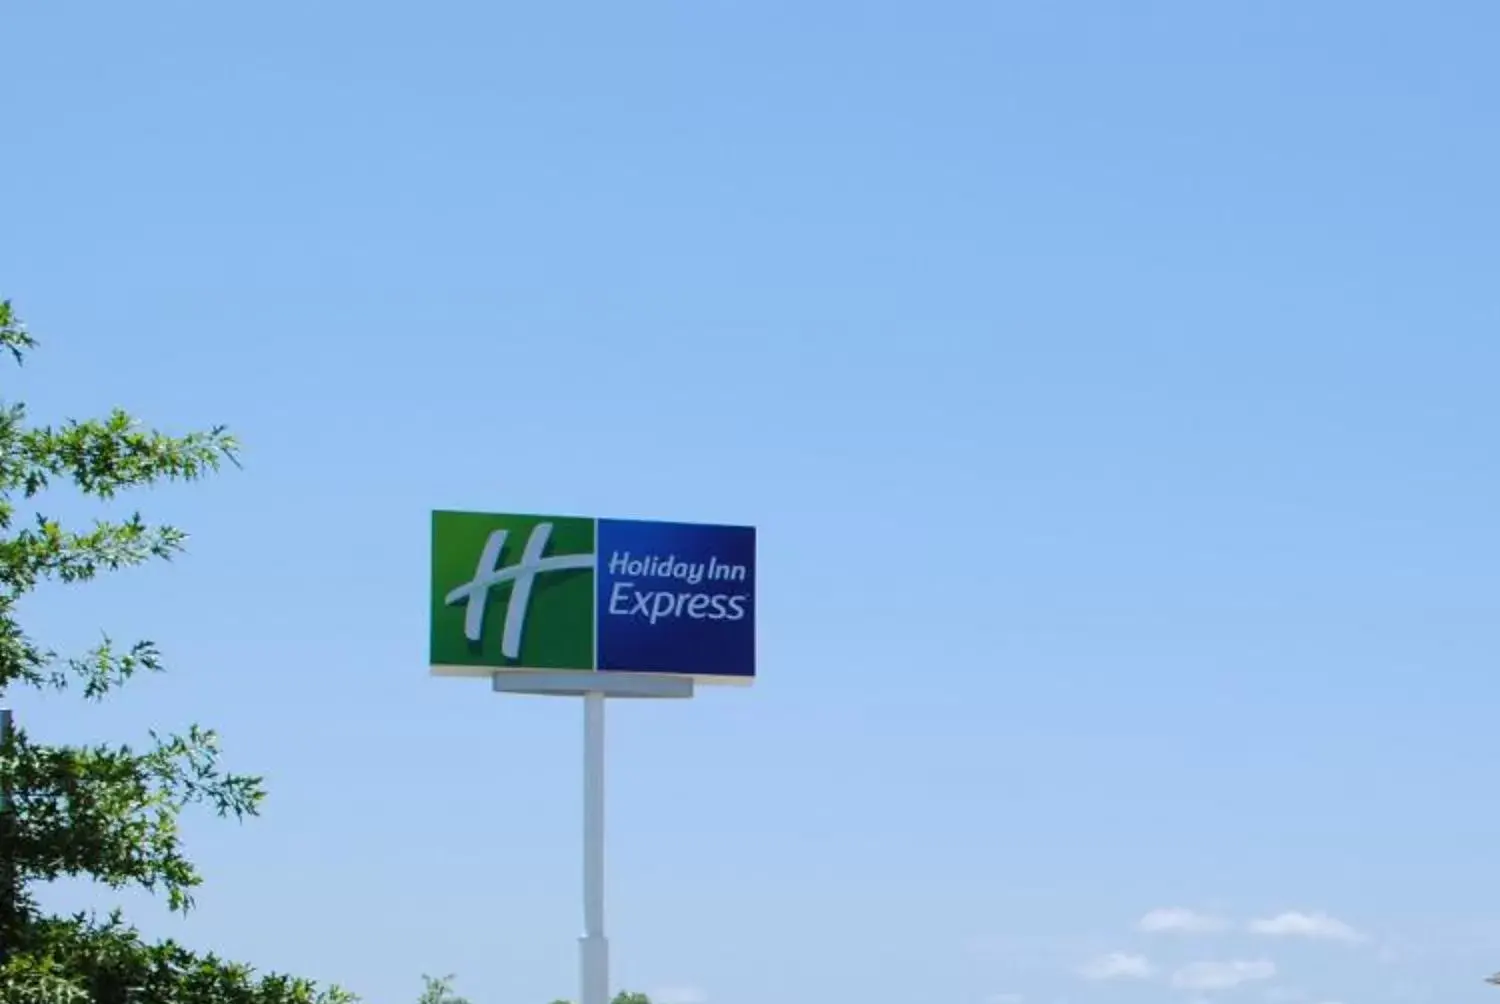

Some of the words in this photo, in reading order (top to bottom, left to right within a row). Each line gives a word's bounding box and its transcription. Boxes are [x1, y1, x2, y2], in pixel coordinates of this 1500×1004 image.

[608, 551, 704, 584] Holiday
[707, 556, 746, 580] Inn
[608, 582, 747, 624] Express
